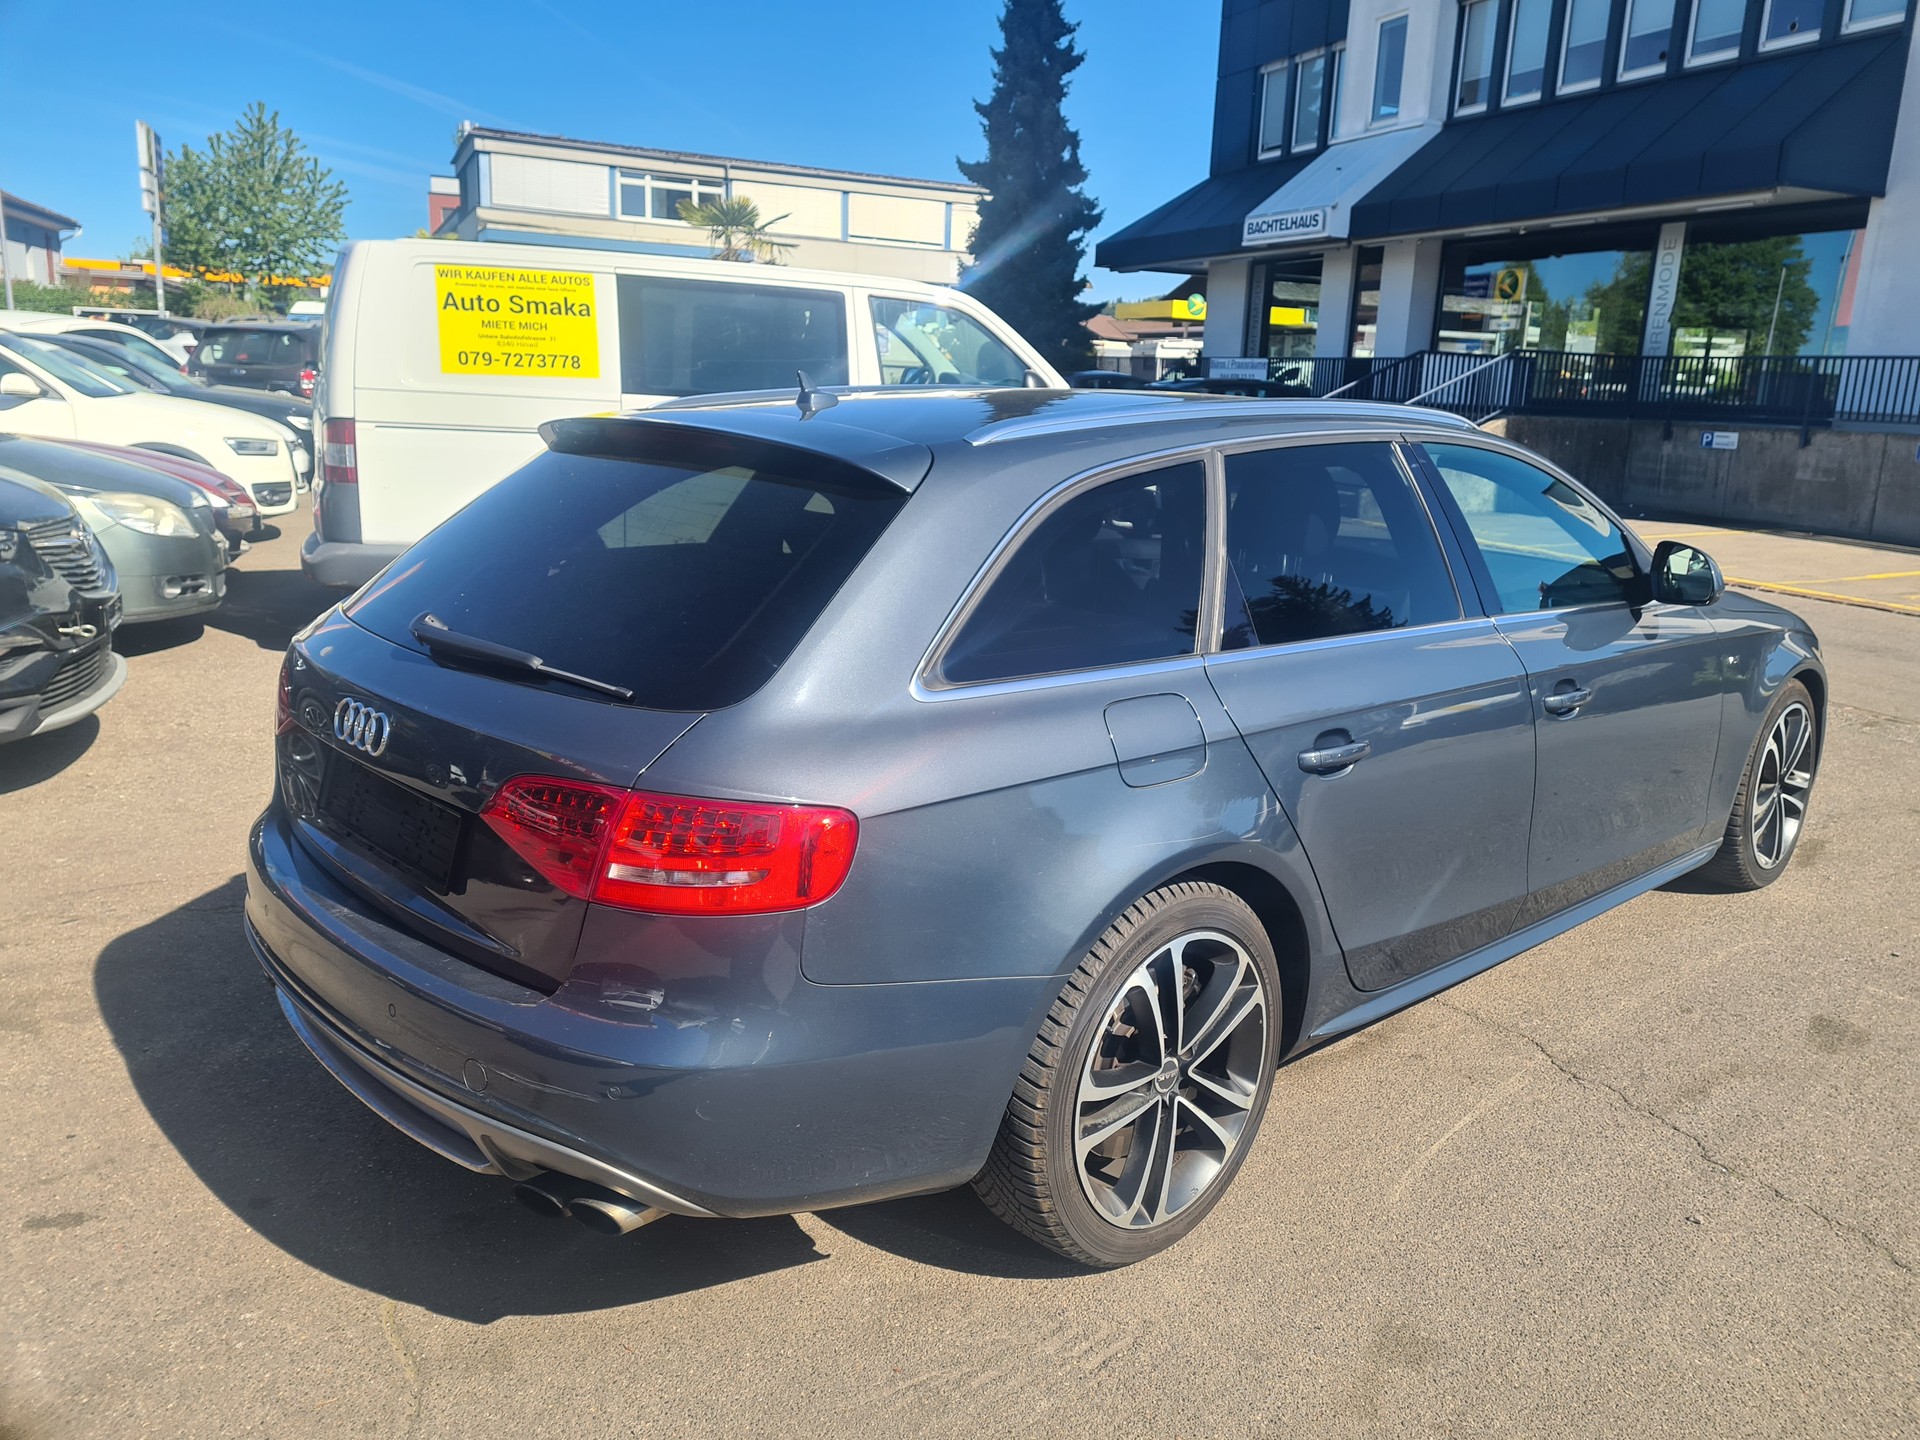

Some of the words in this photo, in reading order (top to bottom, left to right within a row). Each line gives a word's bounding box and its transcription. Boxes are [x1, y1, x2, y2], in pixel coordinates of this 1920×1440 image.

[1247, 213, 1319, 235] BACHTELHAUS
[438, 268, 462, 279] WIR
[466, 270, 515, 282] KAUFEN
[518, 273, 547, 284] ALLE
[551, 275, 591, 287] AUTOS
[442, 292, 500, 313] Auto
[509, 295, 591, 317] Smaka
[1647, 237, 1677, 370] RRENMODE
[481, 320, 515, 330] MIETE
[518, 321, 548, 331] MICH
[458, 350, 581, 370] 079-7273778
[1702, 432, 1713, 448] P
[1113, 931, 1154, 973] YOKOHAMA
